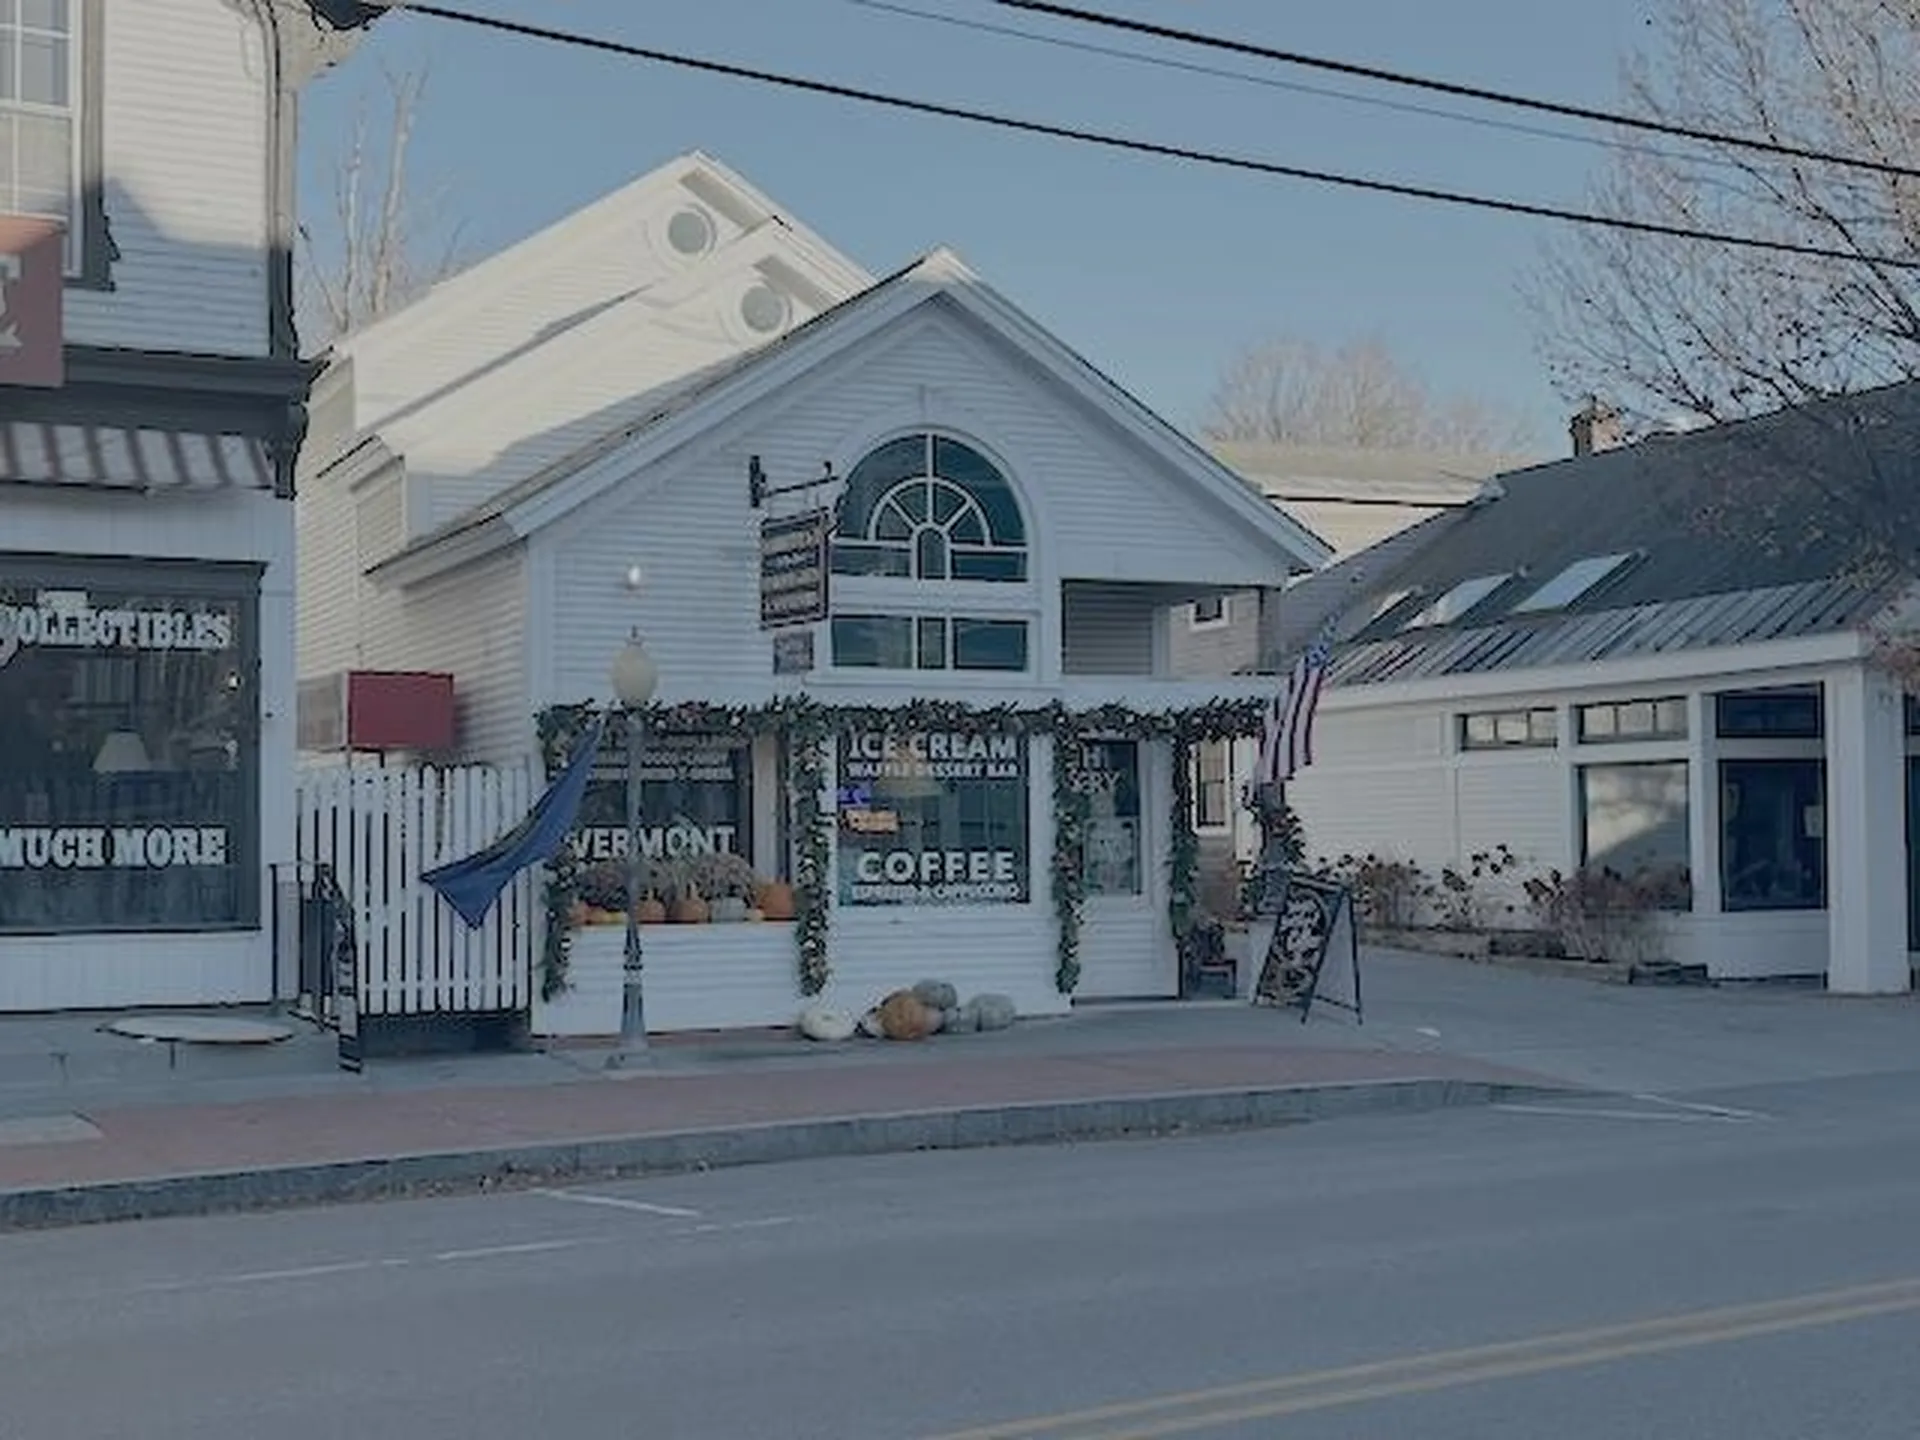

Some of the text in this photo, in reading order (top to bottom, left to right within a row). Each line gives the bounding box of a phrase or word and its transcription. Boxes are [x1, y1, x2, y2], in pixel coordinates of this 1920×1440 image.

[849, 729, 1018, 759] ICE CREAM
[0, 826, 227, 868] MUCH MORE
[571, 825, 737, 859] VERMONT
[857, 850, 1016, 882] COFFEE
